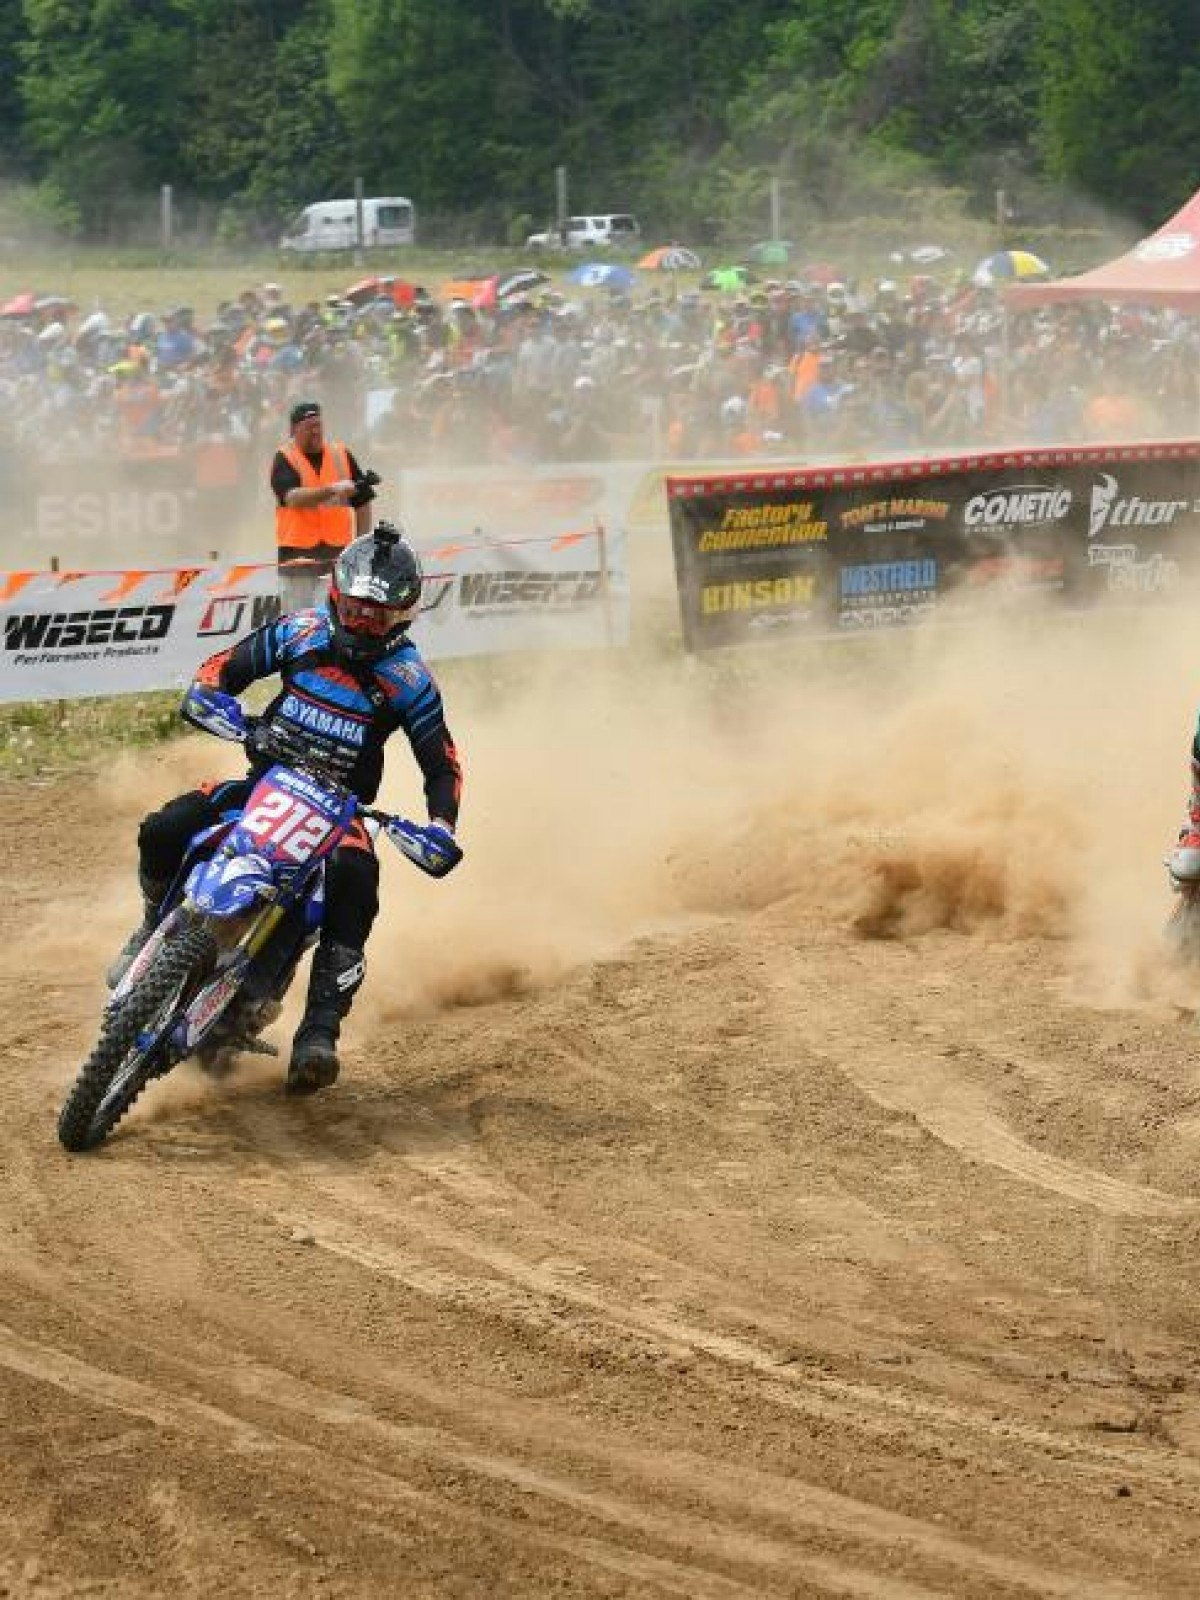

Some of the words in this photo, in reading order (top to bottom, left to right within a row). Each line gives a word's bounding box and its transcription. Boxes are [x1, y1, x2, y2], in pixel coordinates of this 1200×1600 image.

[30, 490, 196, 538] ESHO
[964, 490, 1072, 525] COMETIC
[103, 644, 161, 658] Products
[300, 702, 365, 747] YAMAHA
[240, 790, 334, 863] 212
